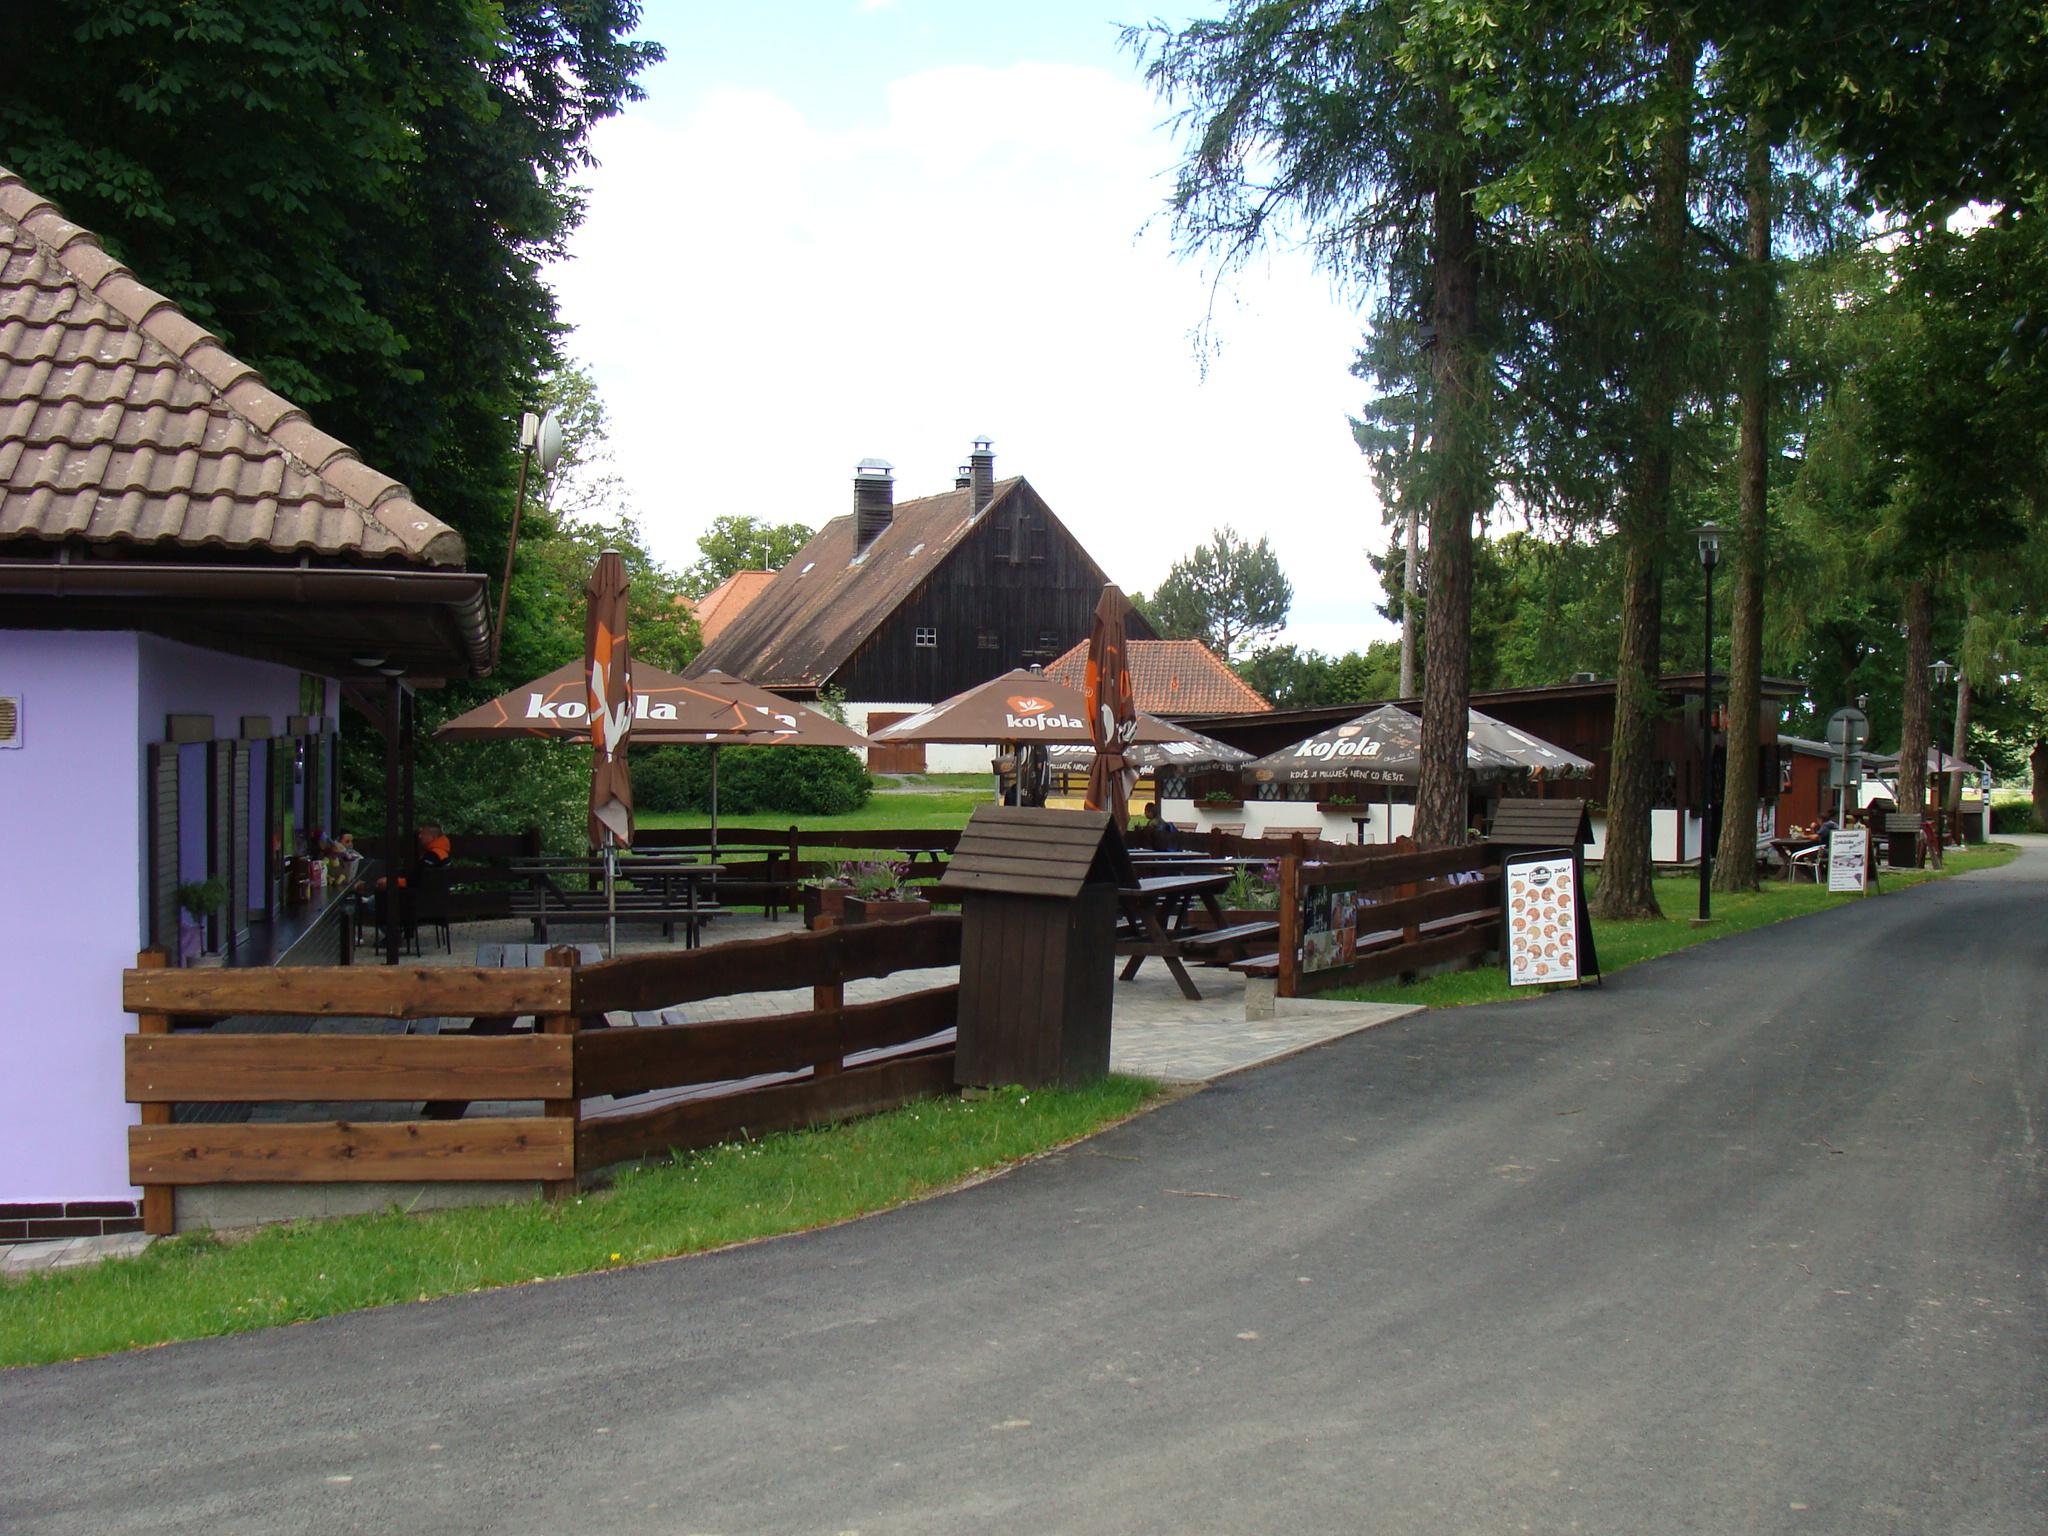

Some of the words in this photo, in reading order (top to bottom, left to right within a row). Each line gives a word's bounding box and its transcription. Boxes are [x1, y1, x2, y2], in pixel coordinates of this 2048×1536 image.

[1007, 713, 1083, 731] kofola
[1294, 737, 1381, 762] kofola
[1290, 769, 1308, 779] KDYŽ
[1371, 771, 1380, 780] CO
